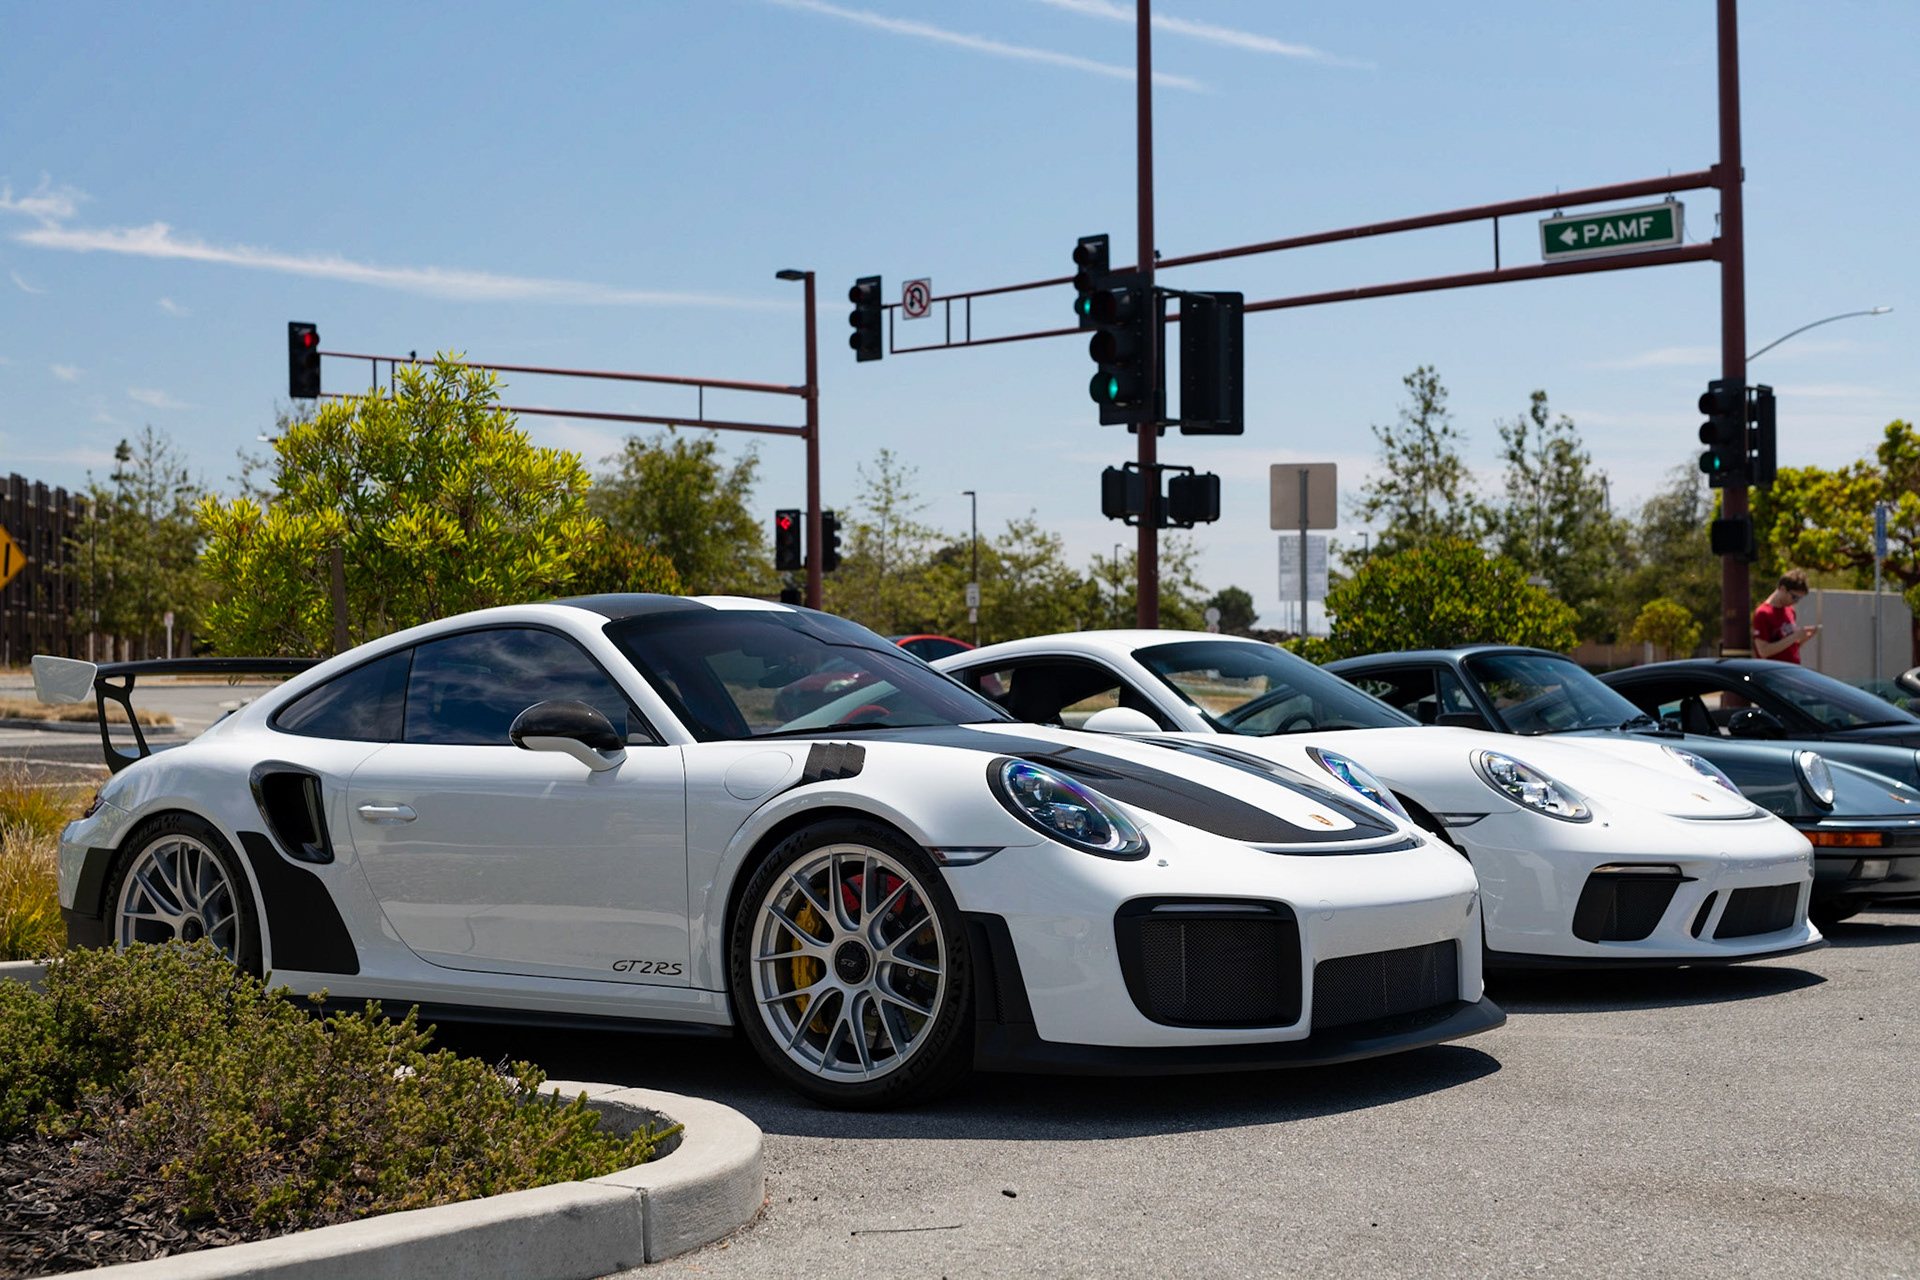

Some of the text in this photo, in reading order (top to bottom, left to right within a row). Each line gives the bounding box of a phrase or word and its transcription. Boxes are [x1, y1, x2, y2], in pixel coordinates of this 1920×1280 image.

[1583, 216, 1653, 244] PAMF
[737, 852, 782, 927] MICHELIN
[612, 960, 683, 975] GT2RS
[908, 1001, 959, 1077] MICHELIN
